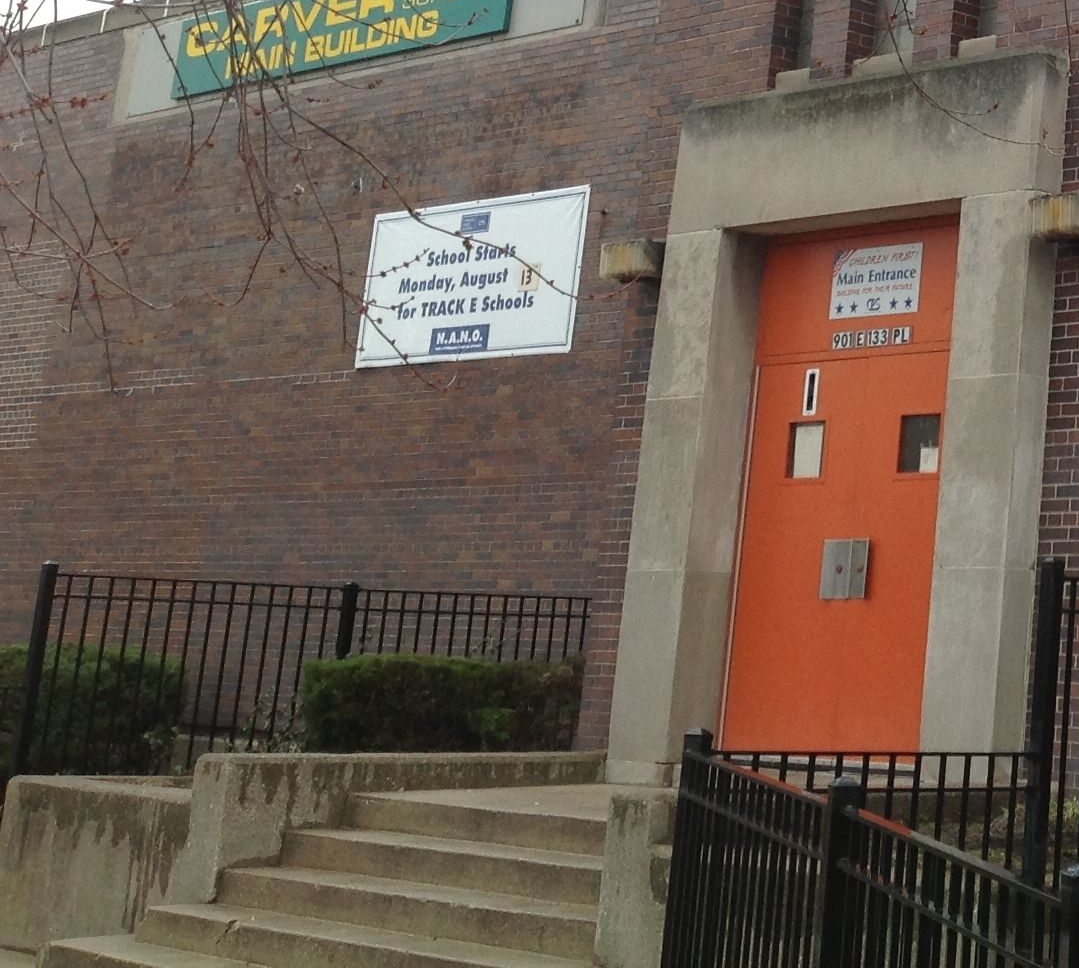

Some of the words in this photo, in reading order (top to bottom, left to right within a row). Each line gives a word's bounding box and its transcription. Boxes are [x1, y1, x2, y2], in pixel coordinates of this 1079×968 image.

[304, 10, 440, 63] BUILDING
[426, 247, 471, 267] School
[474, 243, 516, 262] Starts
[398, 274, 456, 294] Monday,
[460, 268, 509, 290] August
[520, 268, 533, 286] 13
[836, 271, 864, 286] Main
[868, 268, 917, 283] Entrance
[397, 303, 417, 320] for
[421, 298, 465, 317] TRACK
[469, 297, 478, 313] E
[481, 291, 534, 313] Schools
[436, 329, 483, 345] N.A.N.O.
[833, 333, 853, 348] 901
[856, 332, 865, 346] E
[868, 330, 888, 345] 133
[893, 328, 908, 343] PL
